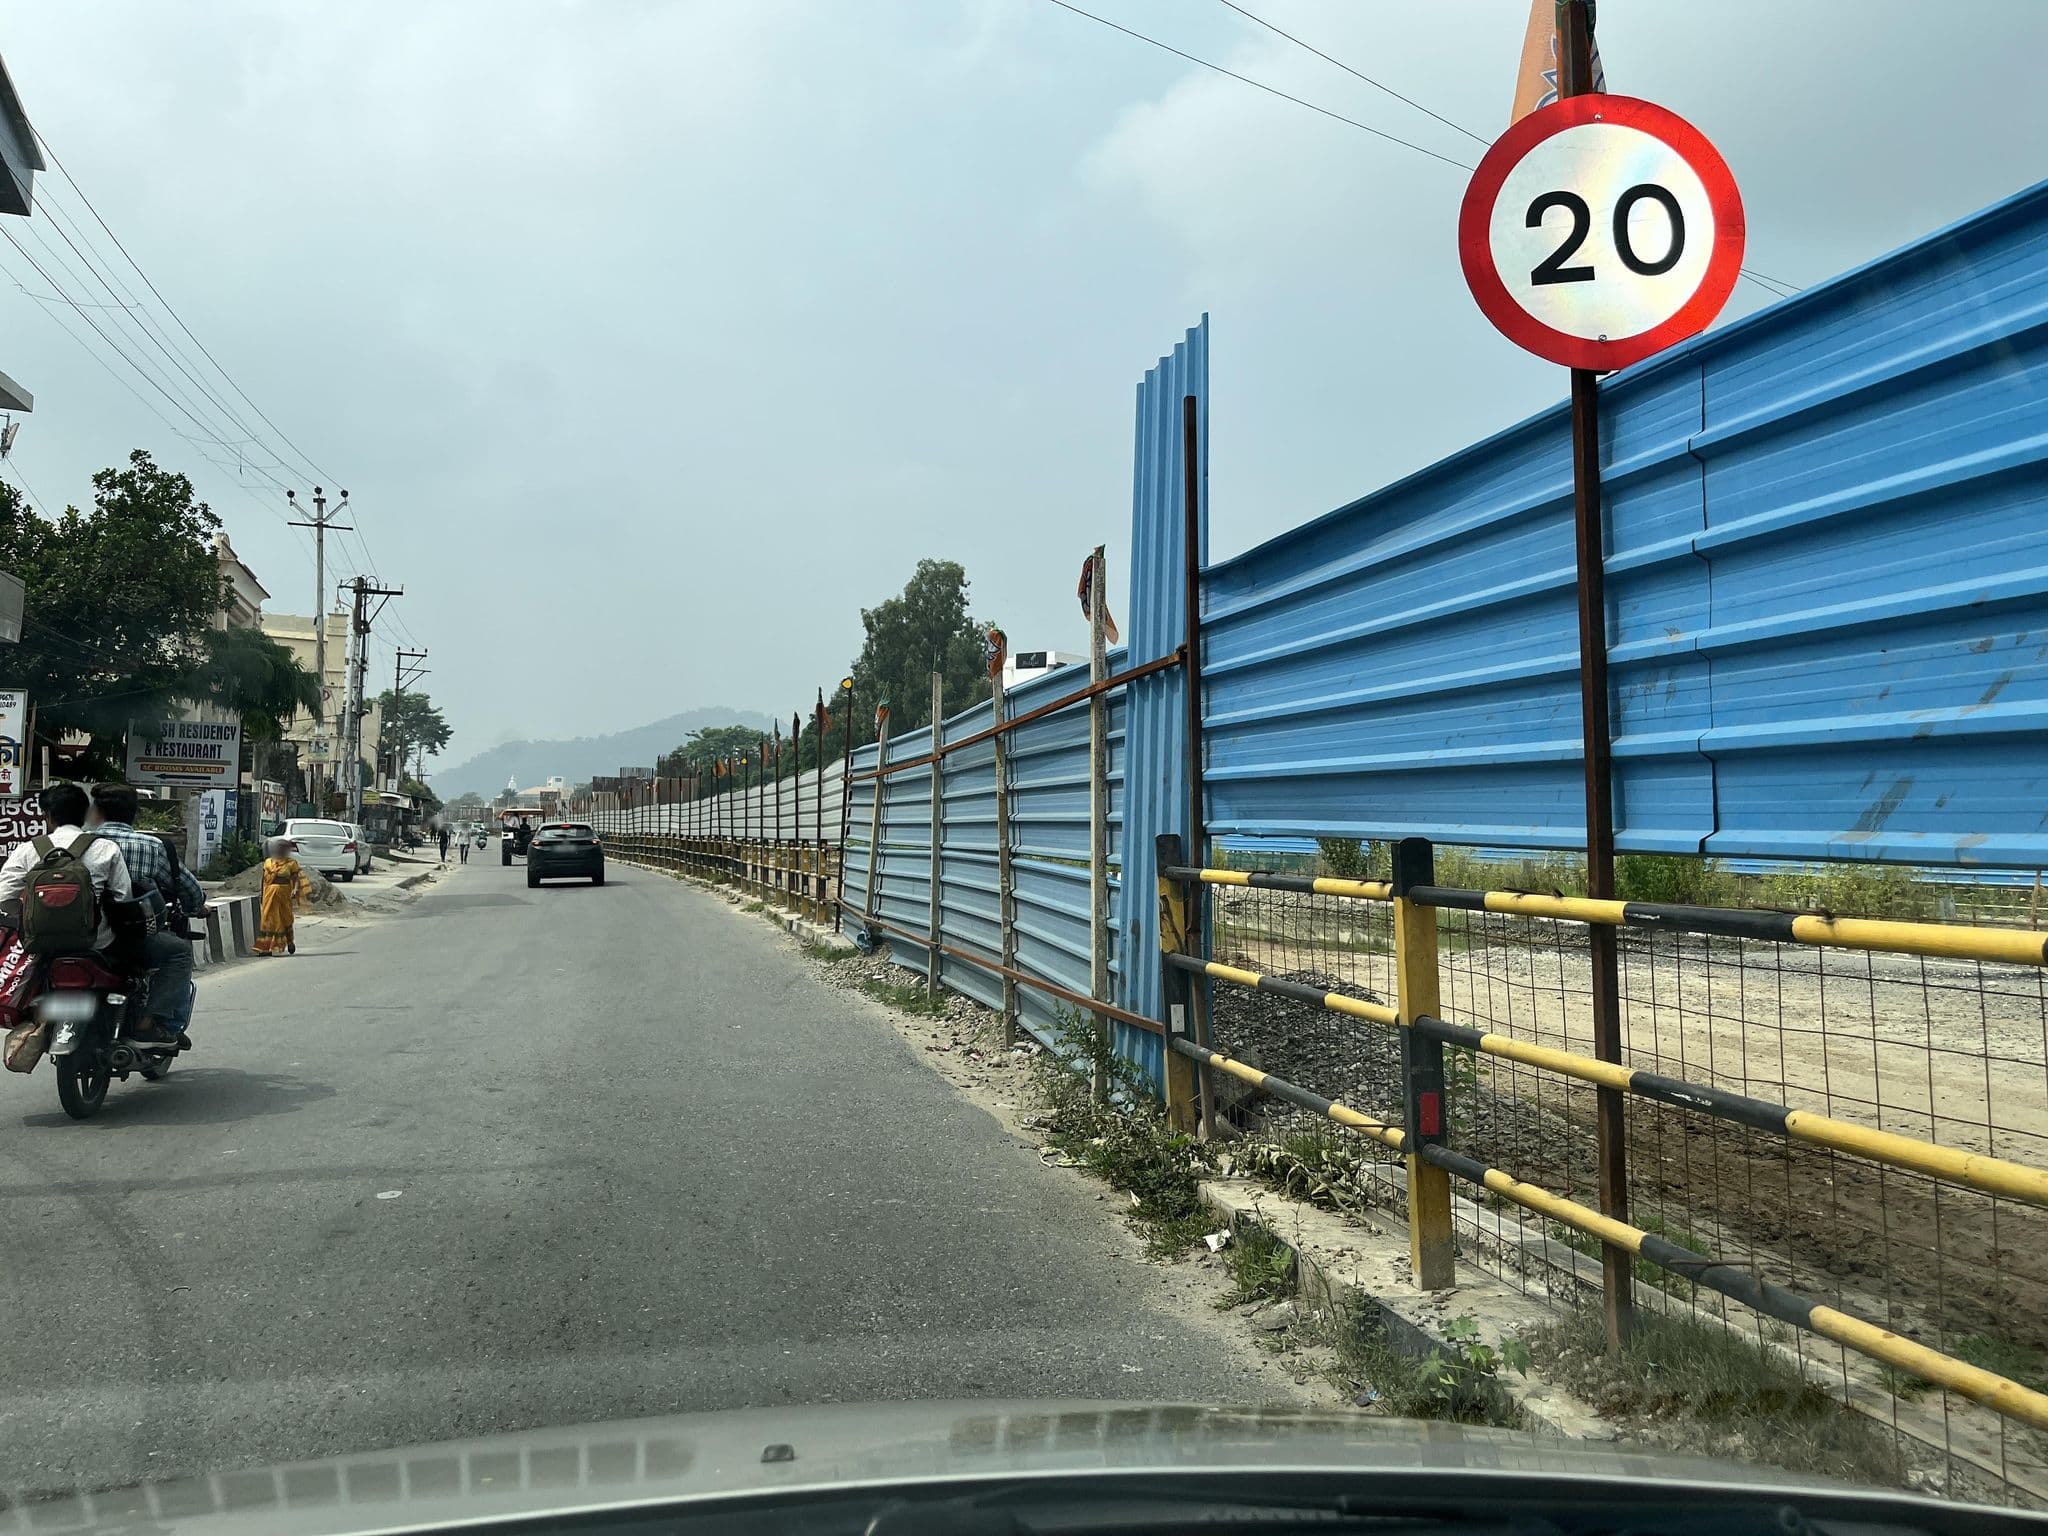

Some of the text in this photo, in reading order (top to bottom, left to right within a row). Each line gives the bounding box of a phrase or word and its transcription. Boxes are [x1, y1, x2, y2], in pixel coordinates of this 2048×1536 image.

[1525, 183, 1686, 287] 20
[179, 724, 237, 742] RESIDENCY
[145, 742, 223, 760] & RESTAURANT
[155, 765, 183, 773] ROOMS
[184, 766, 223, 775] AVAILABLE
